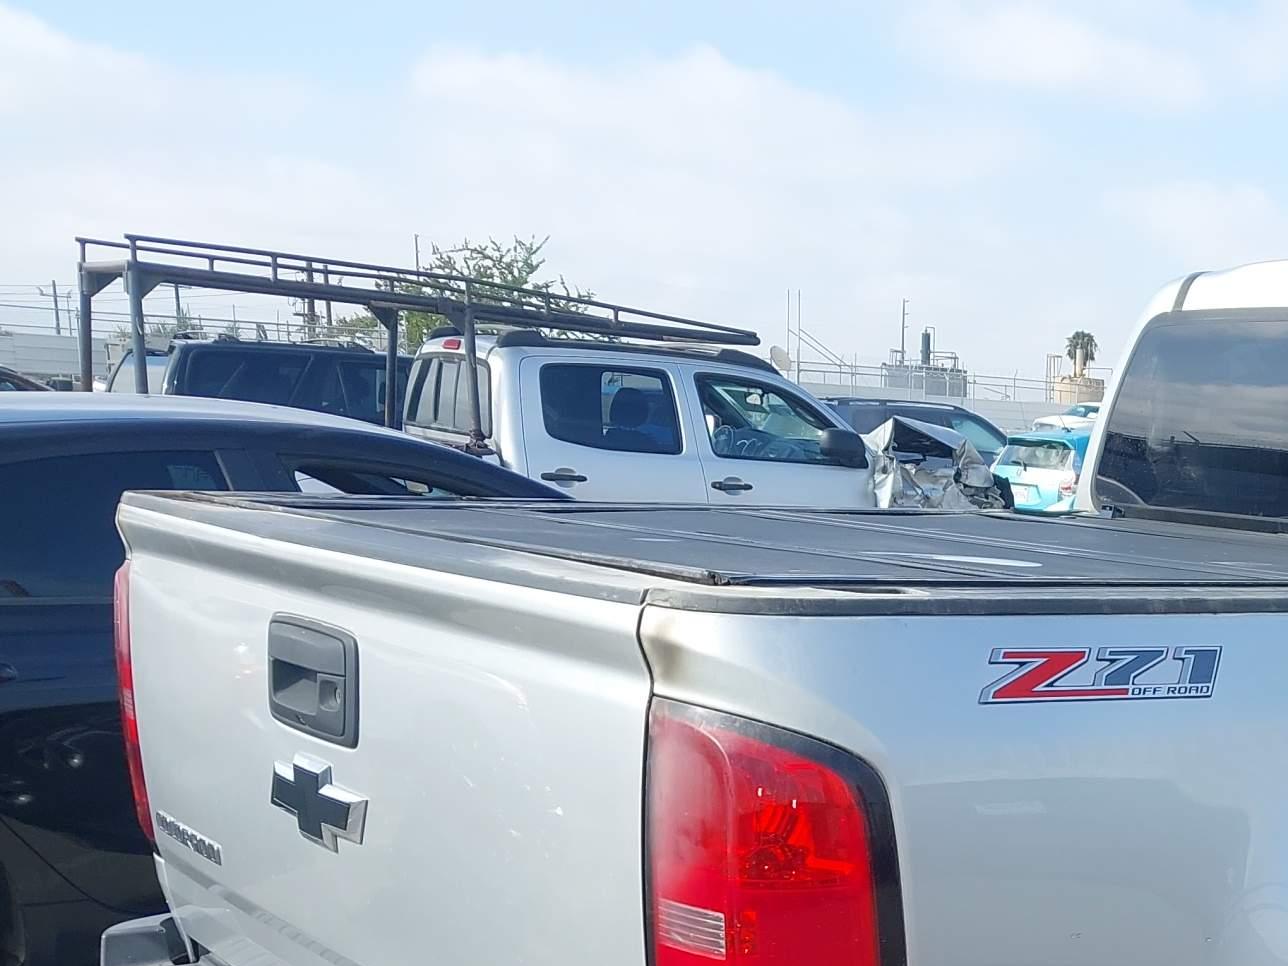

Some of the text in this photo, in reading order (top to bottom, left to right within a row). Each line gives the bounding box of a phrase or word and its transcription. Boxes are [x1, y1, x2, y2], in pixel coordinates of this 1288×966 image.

[978, 646, 1222, 704] Z71
[1131, 685, 1210, 696] OFF ROAD
